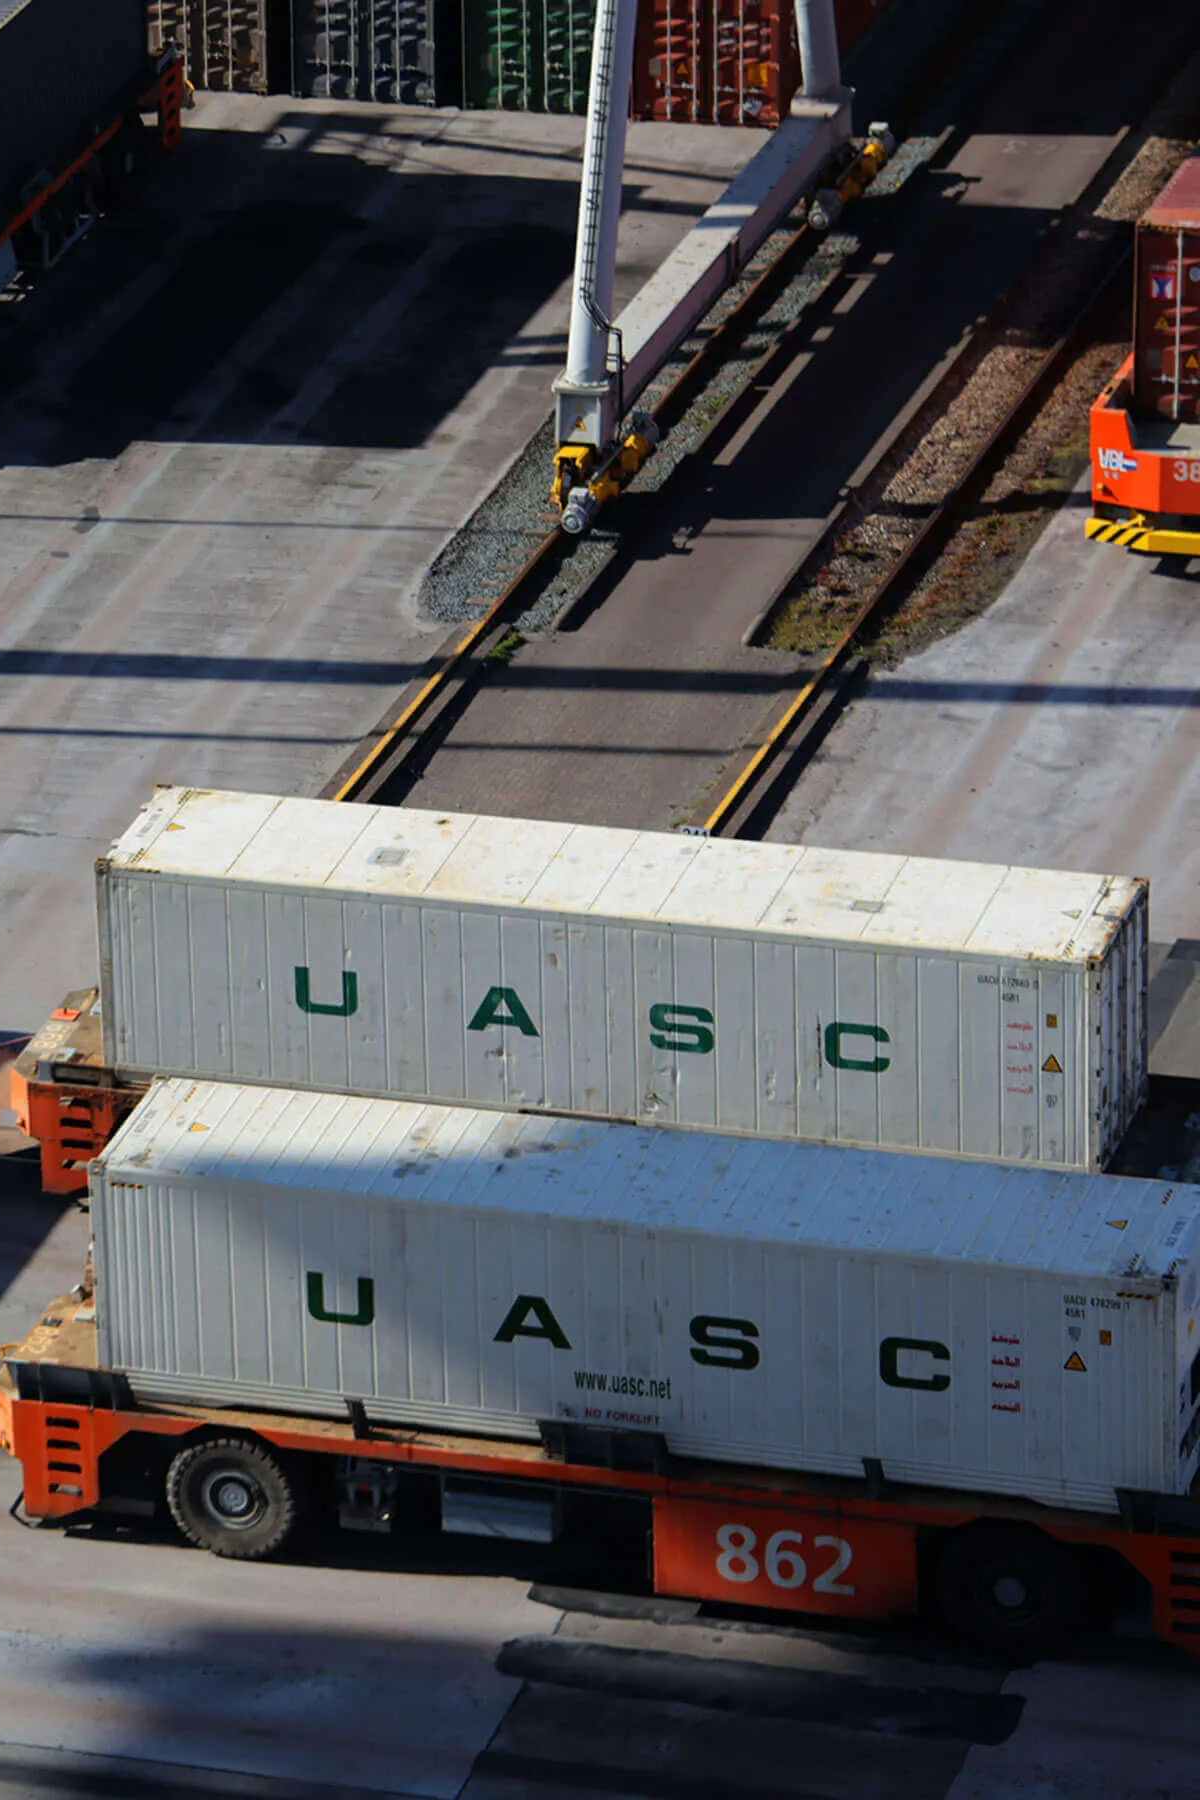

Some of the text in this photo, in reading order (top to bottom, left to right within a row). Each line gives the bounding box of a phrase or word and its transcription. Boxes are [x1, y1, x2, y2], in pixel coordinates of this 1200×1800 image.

[574, 1370, 672, 1401] www.uasc.net
[605, 1408, 660, 1425] FORKLIFT
[714, 1523, 856, 1596] 862
